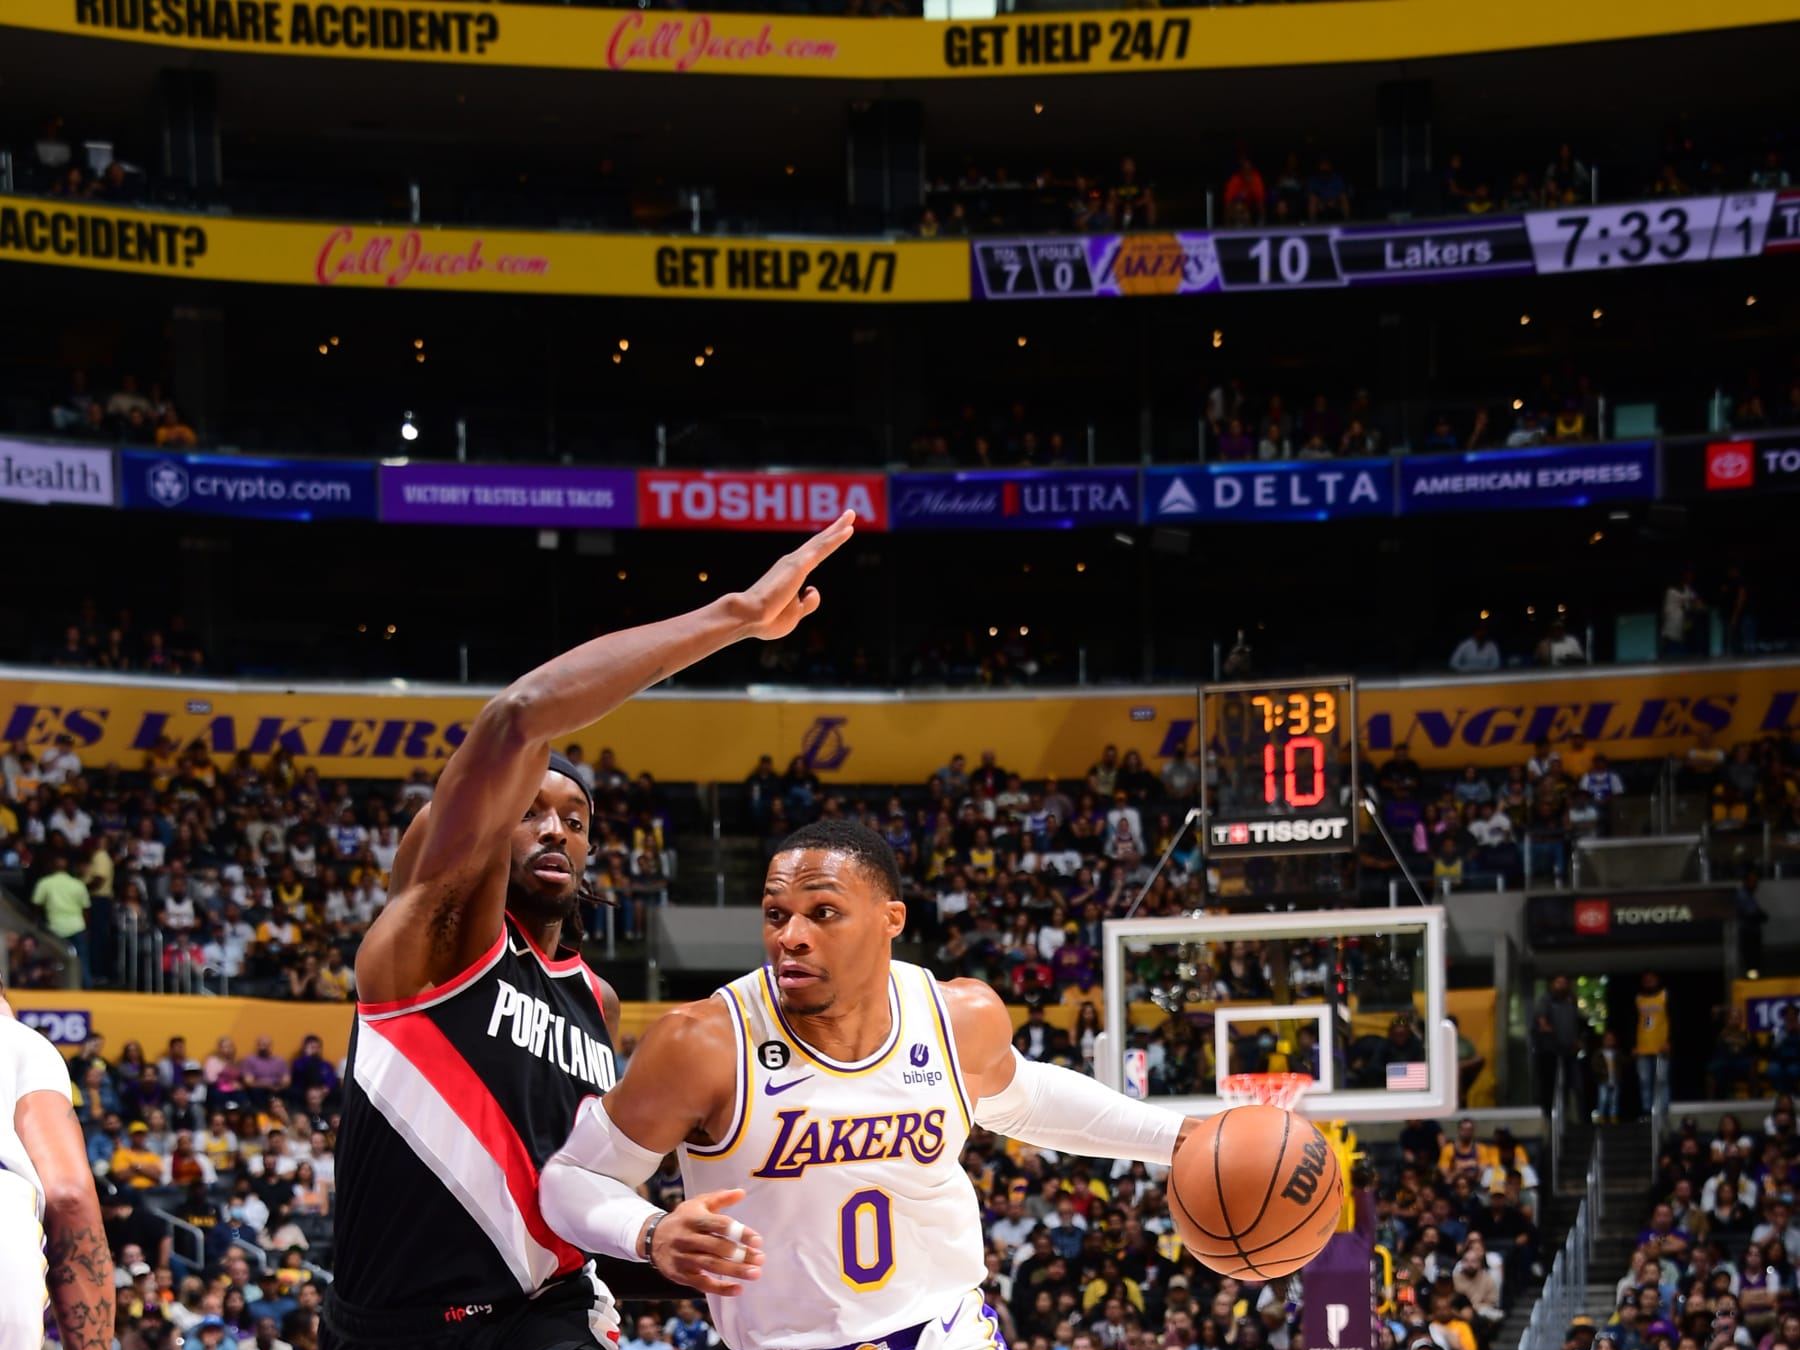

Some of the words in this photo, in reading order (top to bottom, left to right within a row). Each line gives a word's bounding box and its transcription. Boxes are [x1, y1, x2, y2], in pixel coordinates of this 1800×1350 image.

[77, 0, 282, 43] RIDESHARE
[290, 7, 498, 54] ACCIDENT?
[944, 26, 1008, 68] GET
[1017, 22, 1102, 65] HELP
[1109, 18, 1191, 62] 24/7
[0, 207, 208, 268] ACCIDENT?
[1557, 207, 1691, 268] 7:33
[1735, 216, 1753, 253] 1
[656, 247, 719, 289] GET
[727, 248, 810, 290] HELP
[816, 252, 897, 293] 24/7
[1250, 238, 1309, 284] 10
[1385, 239, 1492, 269] Lakers
[1003, 264, 1021, 292] 7
[1053, 262, 1073, 292] 0
[193, 476, 351, 502] crypto.com
[403, 485, 472, 505] VICTORY
[473, 486, 527, 506] TASTES
[529, 488, 565, 507] LIKE
[567, 488, 614, 508] TACOS
[1023, 484, 1132, 513] ULTRA
[1213, 471, 1378, 508] DELTA
[1413, 470, 1531, 496] AMERICAN
[1537, 464, 1642, 487] EXPRESS
[648, 481, 875, 521] TOSHIBA
[1252, 692, 1335, 735] 7:33
[1264, 736, 1325, 807] 10
[1249, 817, 1348, 843] TISSOT
[1615, 907, 1692, 924] TOYOTA
[487, 979, 616, 1093] PORTLAND
[766, 1045, 783, 1068] 6
[903, 1070, 943, 1086] bibigo
[752, 1107, 948, 1180] LAKERS
[838, 1186, 896, 1293] 0
